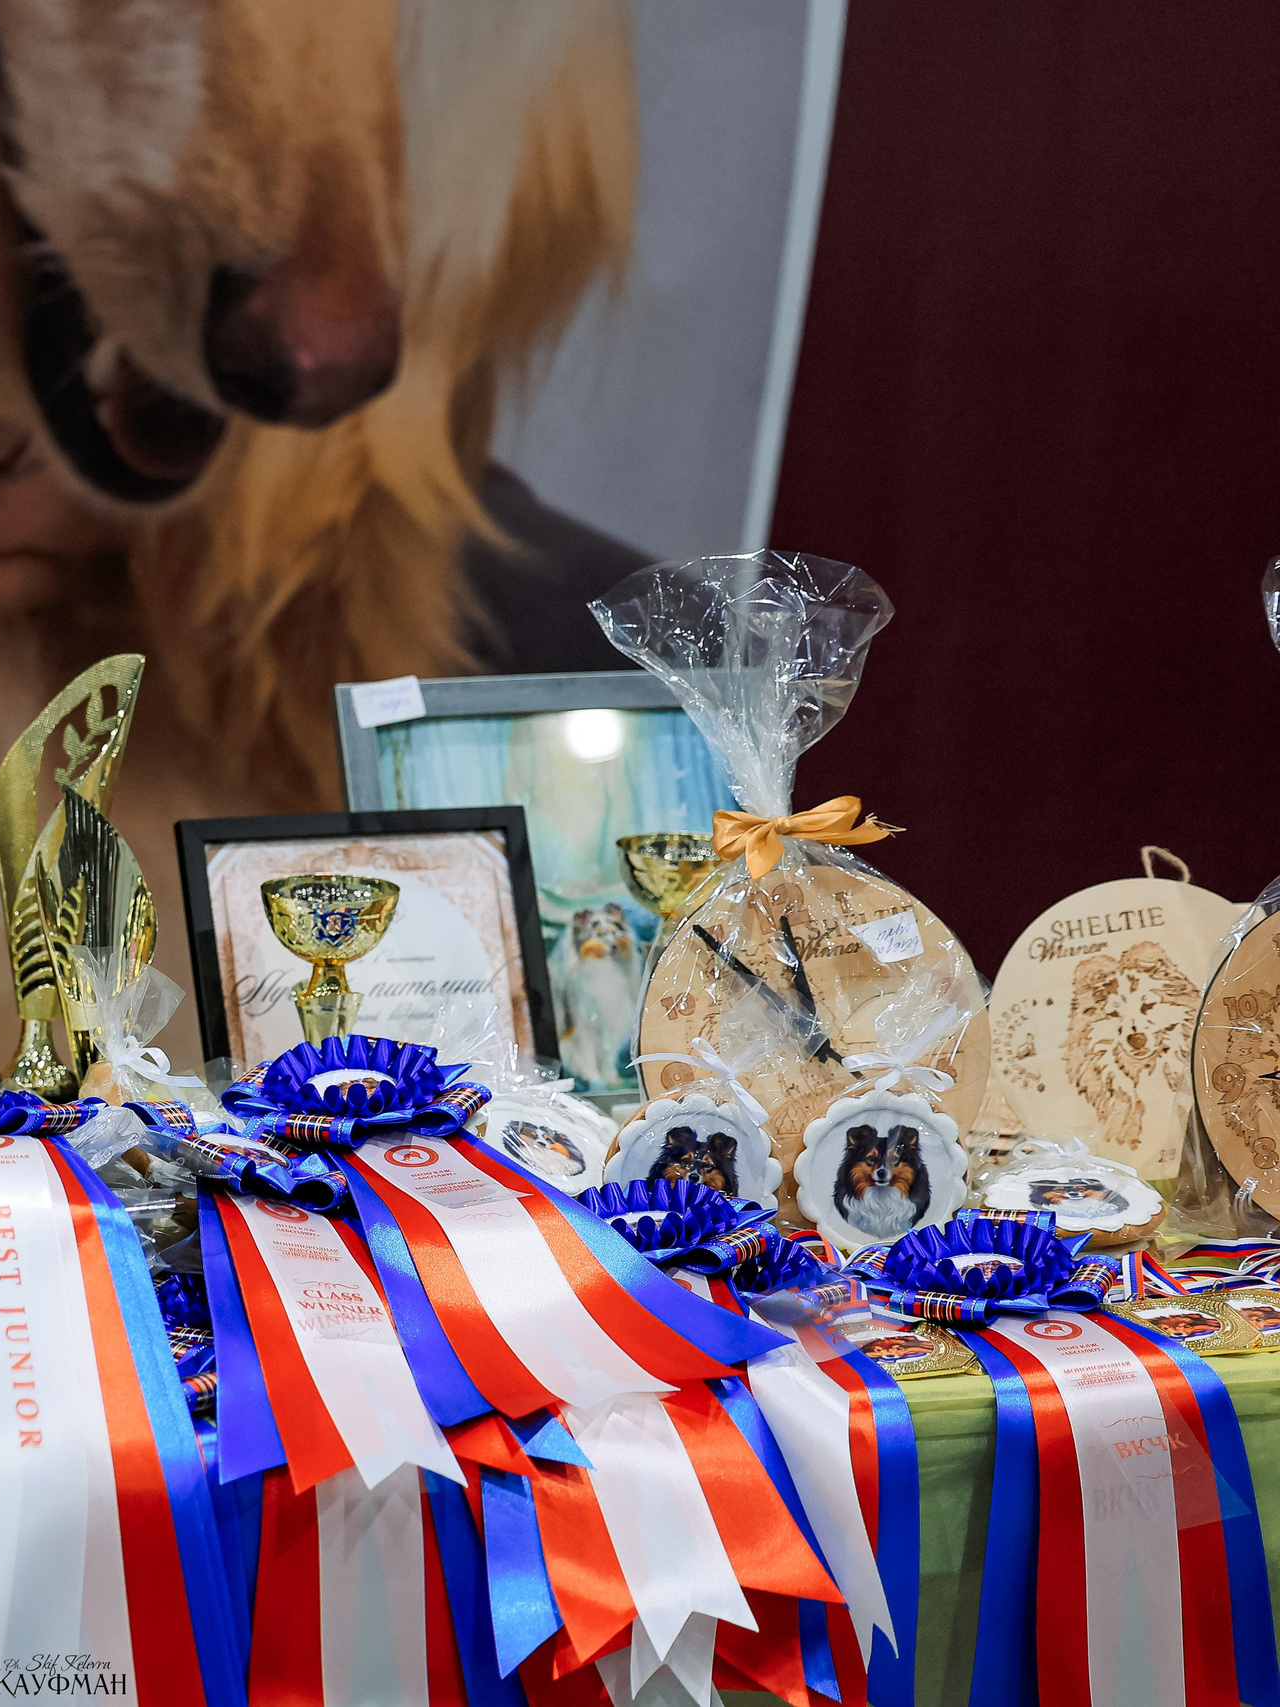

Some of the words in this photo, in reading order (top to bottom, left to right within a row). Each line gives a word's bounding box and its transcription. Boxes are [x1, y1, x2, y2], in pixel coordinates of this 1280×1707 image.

[1050, 906, 1166, 942] SHELTIE
[795, 936, 864, 963] Winner
[1028, 936, 1109, 963] Winner
[660, 991, 697, 1021] 10
[1222, 993, 1259, 1021] 10
[1211, 1062, 1246, 1105] 9
[1252, 1136, 1280, 1169] 8
[272, 1240, 339, 1253] МОНОПОРОДНАЯ
[297, 1300, 384, 1315] WINNER
[303, 1289, 364, 1302] CLASS
[1063, 1360, 1132, 1375] МОНОПОРОДНАЯ
[1081, 1368, 1123, 1379] ВЫСТАВКА
[1113, 1432, 1189, 1459] ВКЧК
